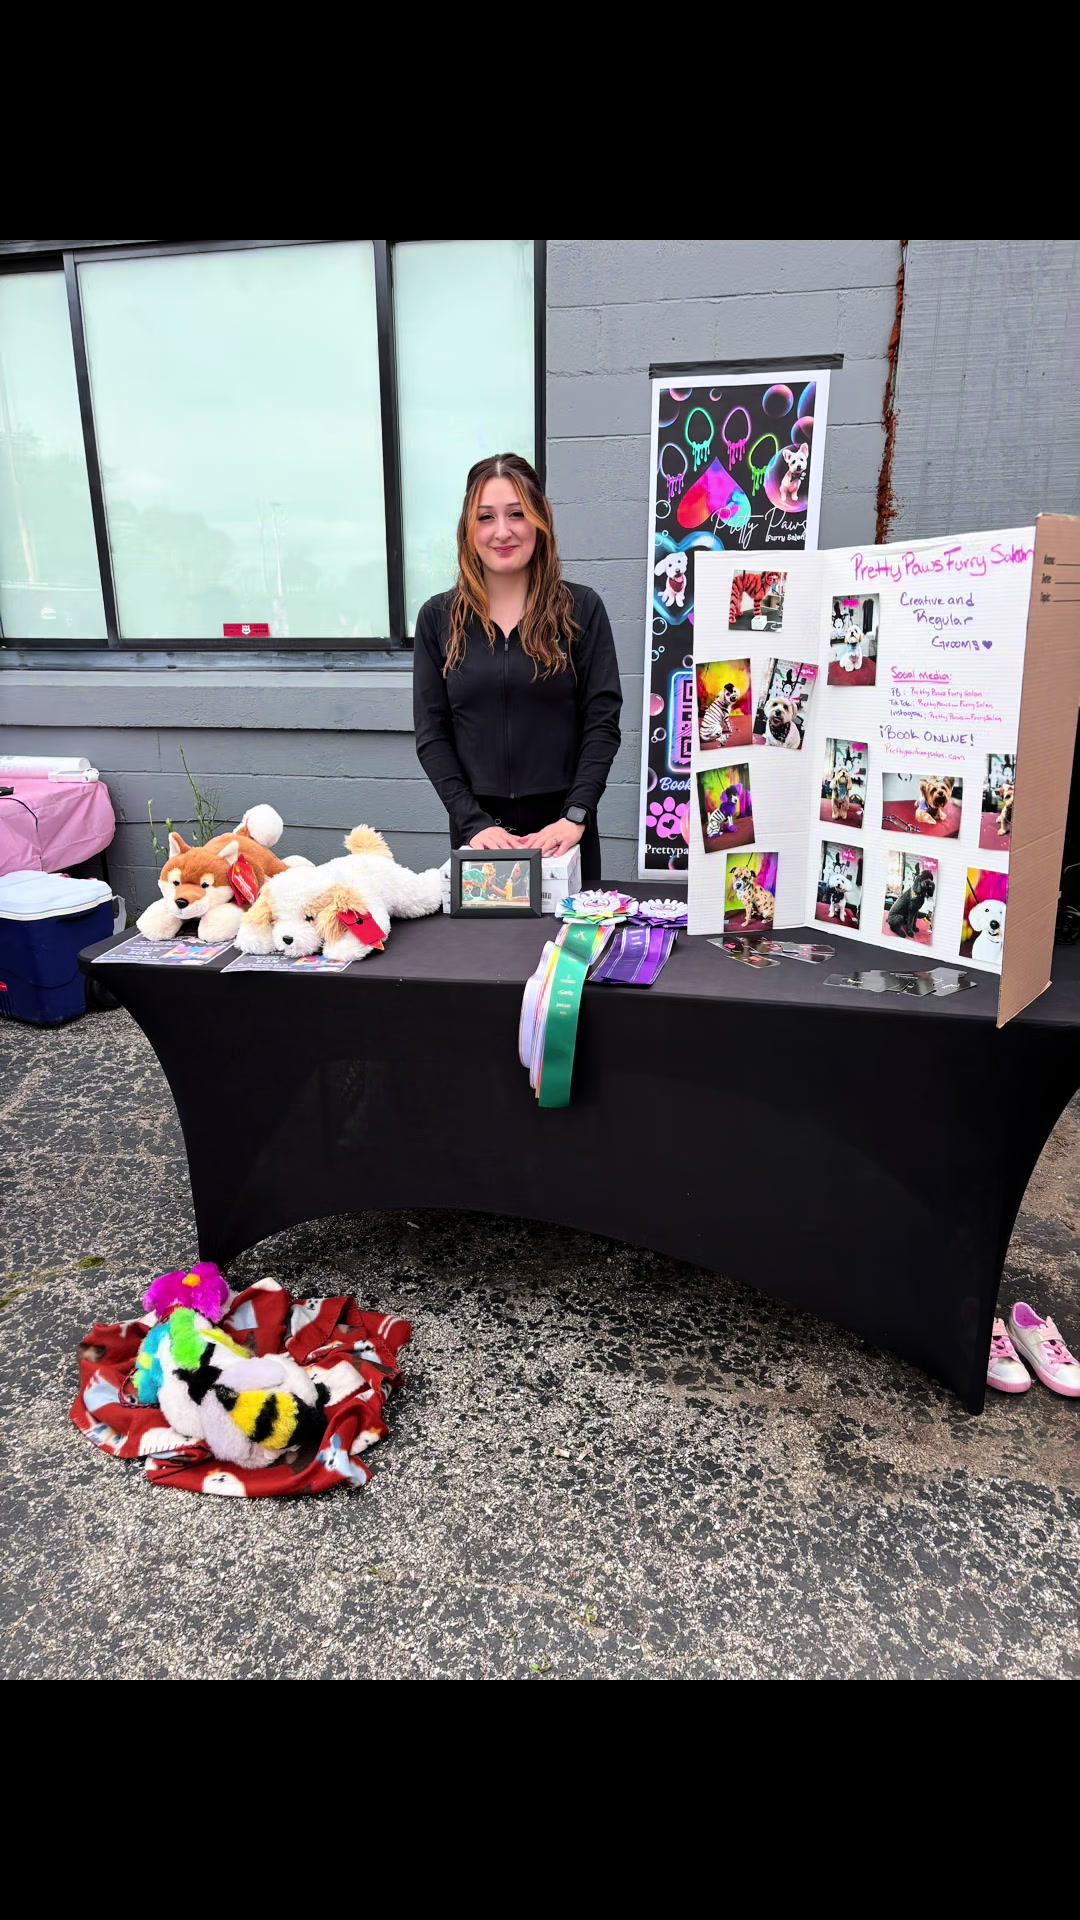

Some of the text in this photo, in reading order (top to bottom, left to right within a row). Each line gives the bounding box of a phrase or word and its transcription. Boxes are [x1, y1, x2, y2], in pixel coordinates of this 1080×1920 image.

[851, 552, 902, 583] Pretty
[902, 551, 944, 577] Paws
[943, 546, 986, 577] Furry
[900, 591, 975, 607] Creative and
[913, 608, 974, 631] Regular
[931, 635, 980, 651] Grooms
[911, 686, 930, 697] Pretty
